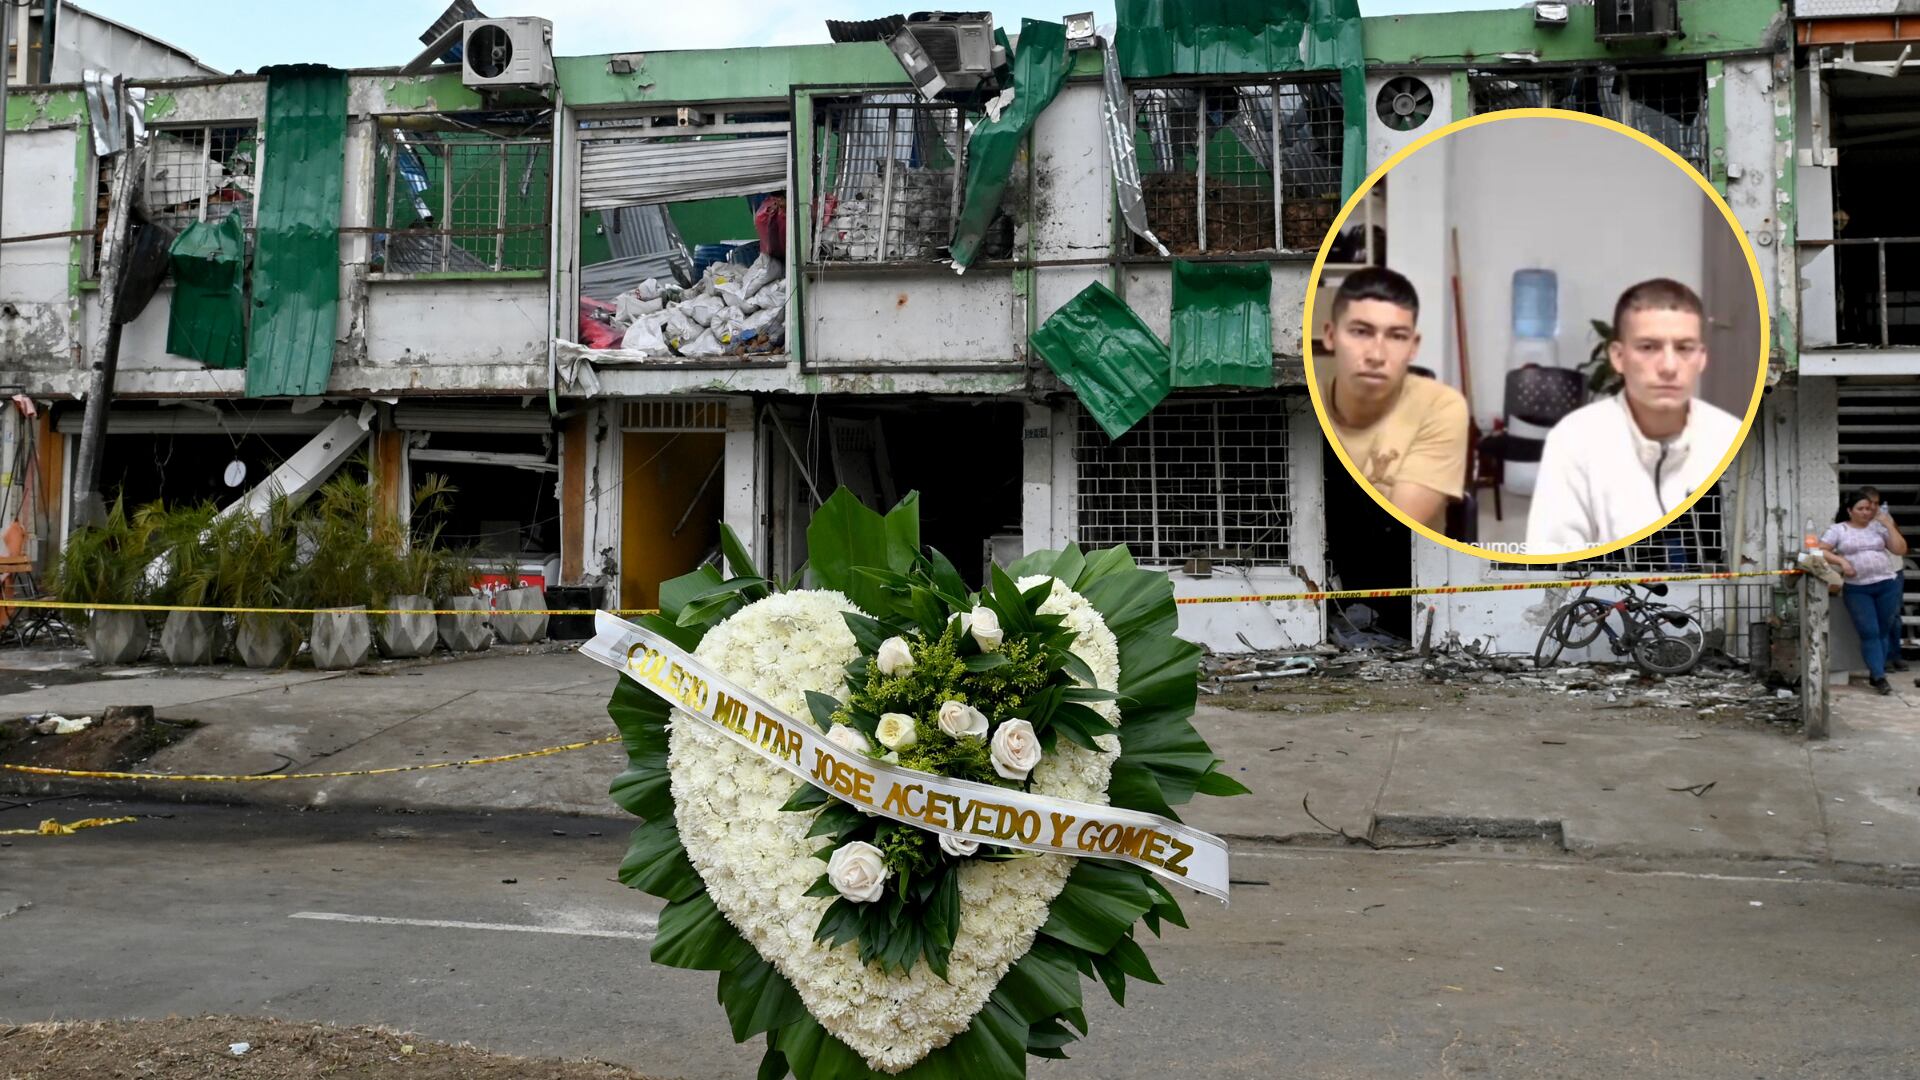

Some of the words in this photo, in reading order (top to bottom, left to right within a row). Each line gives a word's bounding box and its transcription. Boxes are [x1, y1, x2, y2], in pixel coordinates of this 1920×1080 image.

[627, 642, 709, 712] COLEGIO
[712, 691, 803, 766] MILITAR
[811, 747, 875, 804] JOSE
[882, 782, 1041, 844] ACEVEDO
[1050, 812, 1075, 847] Y
[1077, 820, 1194, 877] GOMEZ
